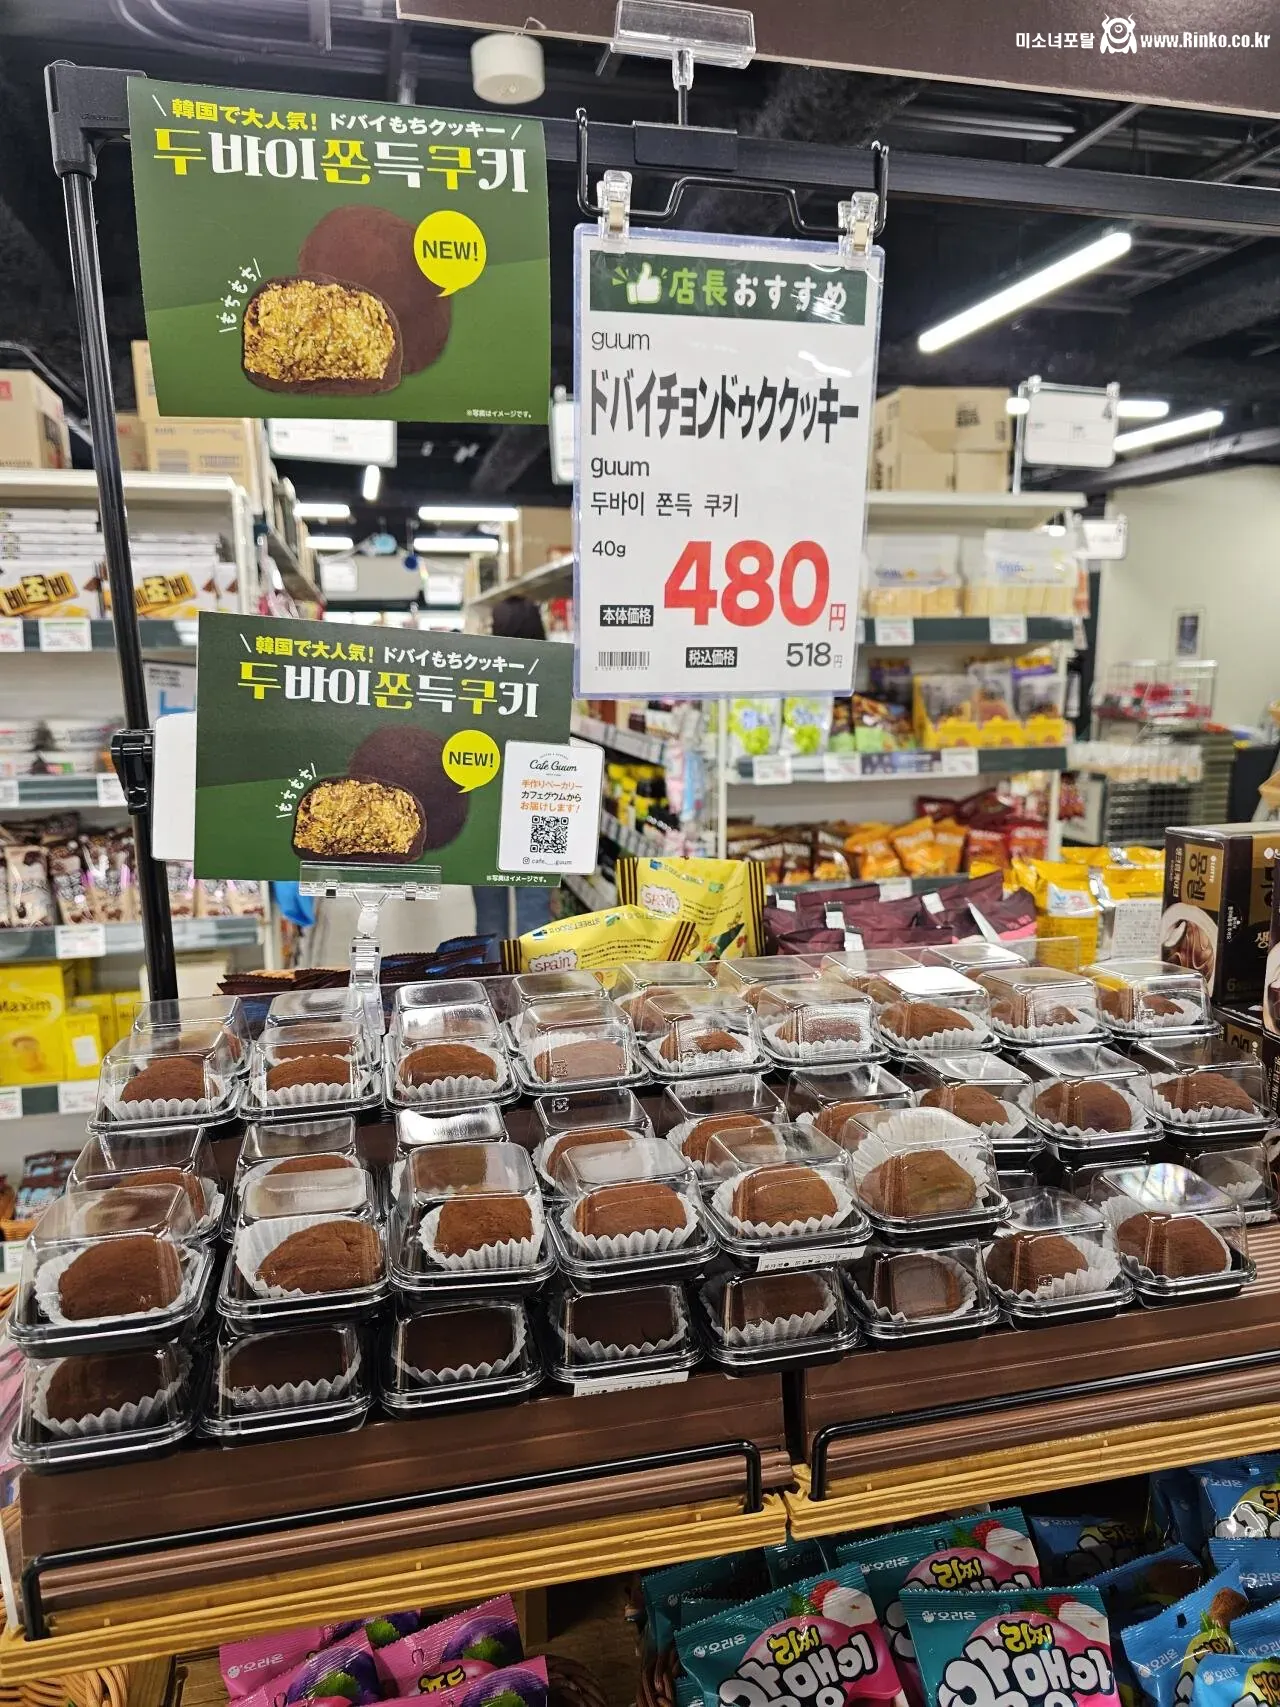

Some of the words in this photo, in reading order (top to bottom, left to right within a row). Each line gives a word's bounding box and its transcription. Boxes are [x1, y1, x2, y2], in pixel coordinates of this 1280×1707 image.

[172, 98, 318, 131] 韓国で大人気!
[329, 112, 506, 139] ドバイもちクッキー
[153, 128, 529, 193] 두바이쫀득쿠키
[422, 239, 479, 262] NEW!
[216, 266, 257, 324] もちもち
[591, 330, 650, 351] guum
[591, 368, 859, 443] ドバイチョンドゥククッキー
[591, 457, 650, 478] guum
[591, 491, 645, 516] 두바이
[656, 492, 693, 517] 쫀득
[704, 493, 739, 517] 쿠키
[592, 540, 626, 557] 40g
[602, 607, 652, 625] 本体価格
[256, 636, 375, 664] 韓国で大人気!
[384, 647, 525, 672] ドバイもちクッキー
[688, 650, 736, 667] 税込価格
[238, 662, 539, 718] 두바이쫀득쿠키
[448, 753, 495, 767] NEW!
[529, 759, 550, 771] Cafe
[551, 760, 577, 772] Guum
[275, 768, 313, 812] もちもち
[521, 779, 583, 790] 手作りベーカリー
[520, 801, 581, 813] お届けします!
[521, 790, 582, 802] カフェグウムから
[1187, 851, 1207, 901] 몽쉘
[937, 1611, 977, 1621] 오리온
[708, 1633, 747, 1655] 오리온
[243, 1652, 285, 1674] 오리온
[1149, 1648, 1180, 1670] 오리온
